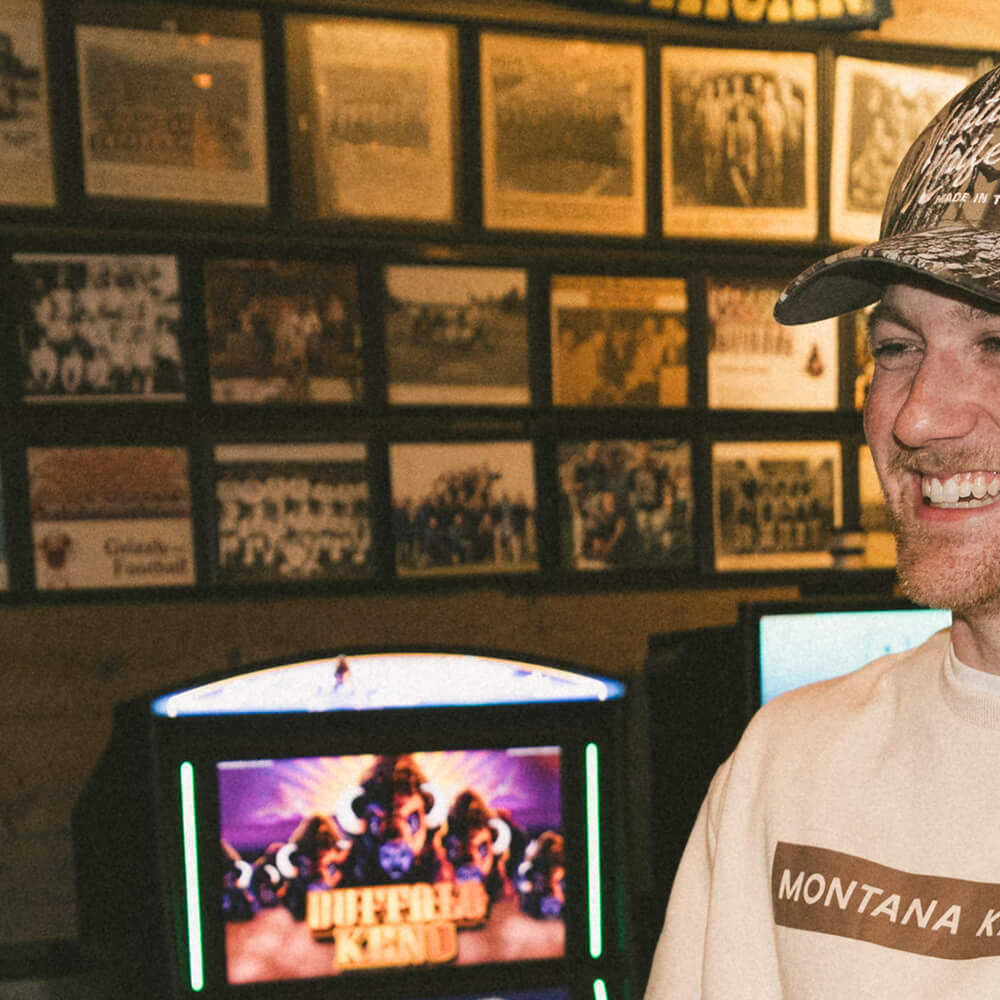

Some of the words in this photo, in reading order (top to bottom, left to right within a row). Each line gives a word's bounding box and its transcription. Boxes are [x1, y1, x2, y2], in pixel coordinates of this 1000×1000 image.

[934, 191, 969, 205] MADE
[973, 192, 988, 204] IN
[778, 868, 962, 936] MONTANA
